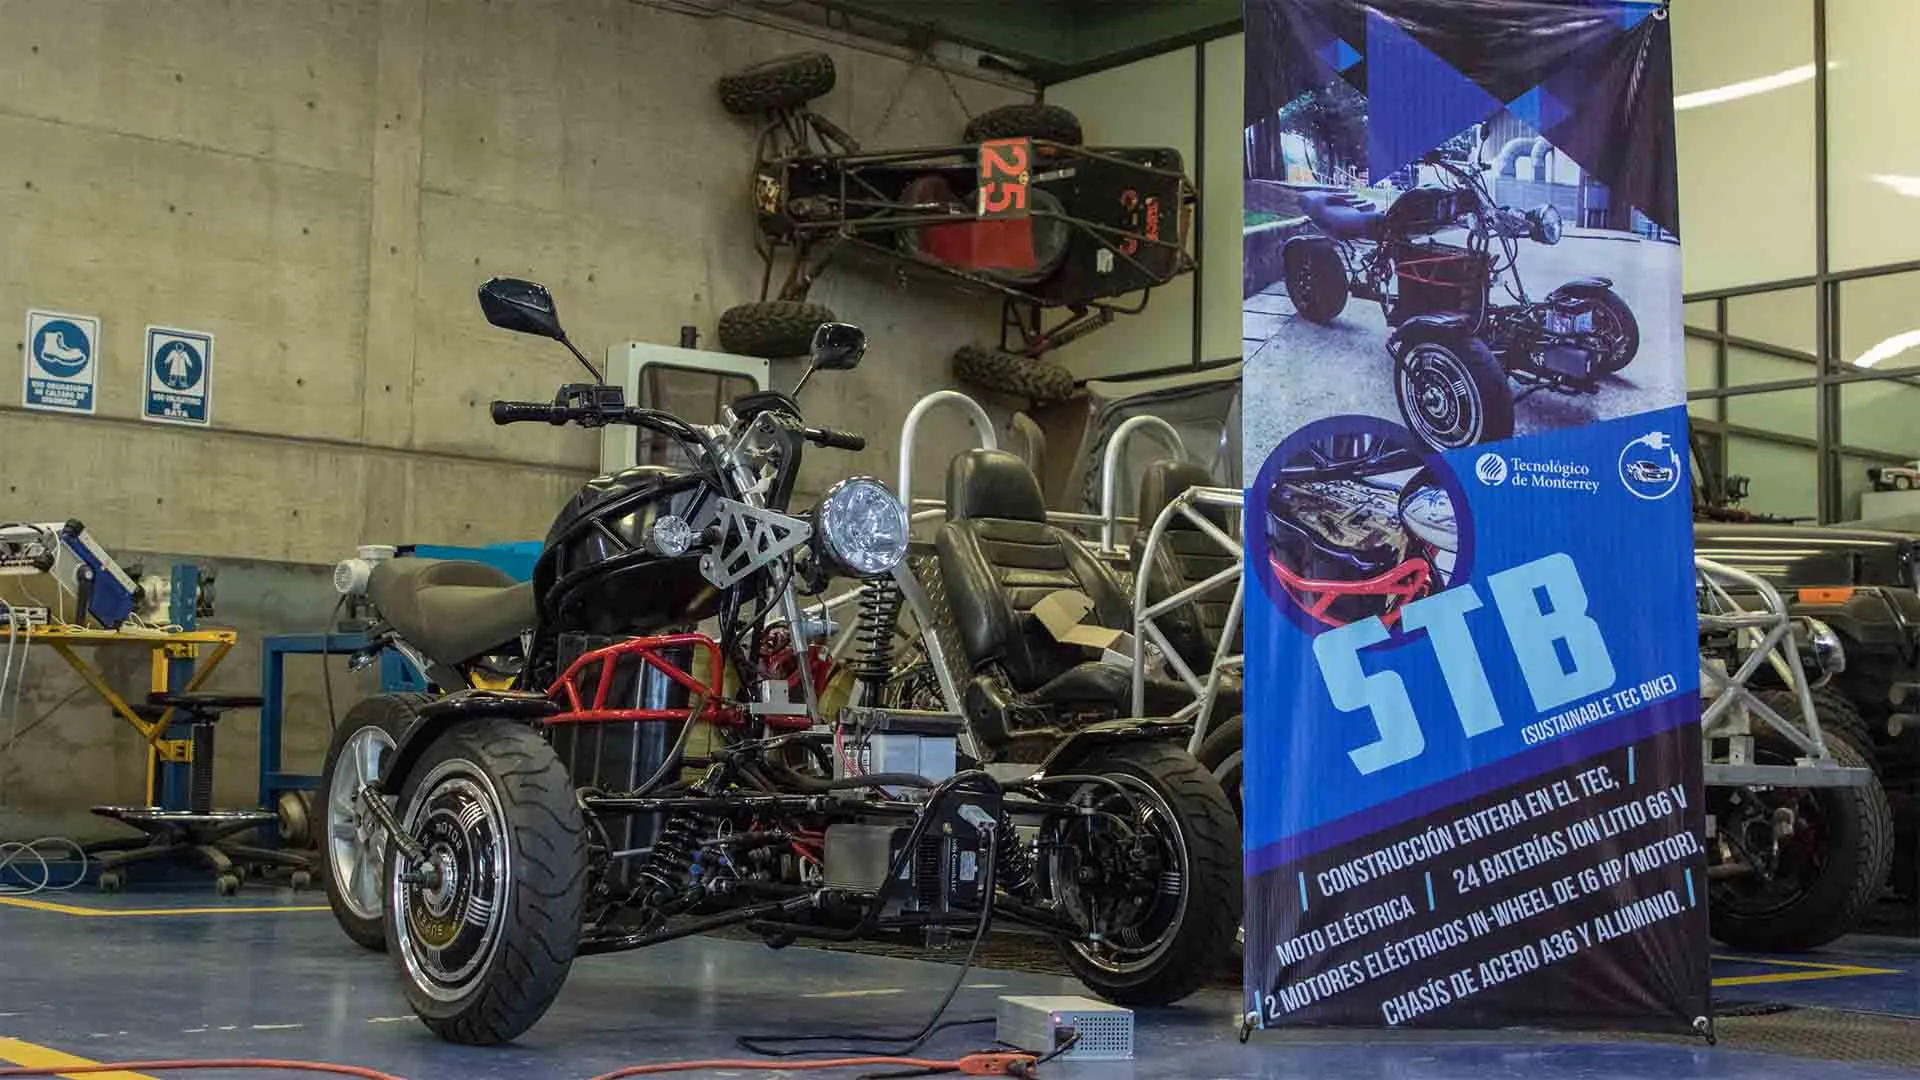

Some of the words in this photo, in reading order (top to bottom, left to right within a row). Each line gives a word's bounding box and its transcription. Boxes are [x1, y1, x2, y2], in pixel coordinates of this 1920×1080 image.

[1511, 458, 1590, 478] Tecnológico
[1511, 472, 1528, 486] de
[1531, 474, 1600, 495] Monterrey
[1312, 552, 1616, 775] STB
[1521, 697, 1615, 745] (SUSTAINABLE
[1612, 687, 1640, 712] TEC
[1639, 673, 1677, 702] BIKE)
[1316, 823, 1456, 897] CONSTRUCCIÓN
[1454, 798, 1528, 845] ENTERA
[1525, 787, 1555, 818] EN
[1552, 780, 1580, 806] EL
[1576, 765, 1620, 798] TEC,
[1452, 865, 1481, 895] 24
[1480, 833, 1568, 884] BATERÍAS
[1566, 818, 1601, 851] ION
[1600, 801, 1647, 838] LITIO
[1645, 791, 1673, 820] 66
[1670, 783, 1688, 809] V
[1264, 995, 1281, 1020] 2
[1280, 961, 1365, 1014] MOTORES
[1364, 919, 1469, 983] ELÉCTRICOS
[1467, 886, 1555, 937] IN-WHEEL
[1551, 876, 1580, 905] DE
[1599, 831, 1705, 887] HP/MOTOR),
[1275, 929, 1325, 968] MOTO
[1324, 894, 1417, 947] ELÉCTRICA
[1381, 978, 1452, 1026] CHASÍS
[1449, 969, 1479, 999] DE
[1479, 944, 1540, 989] ACERO
[1540, 931, 1579, 967] A36
[1574, 925, 1592, 948] Y
[1595, 889, 1687, 944] ALUMINIO.
